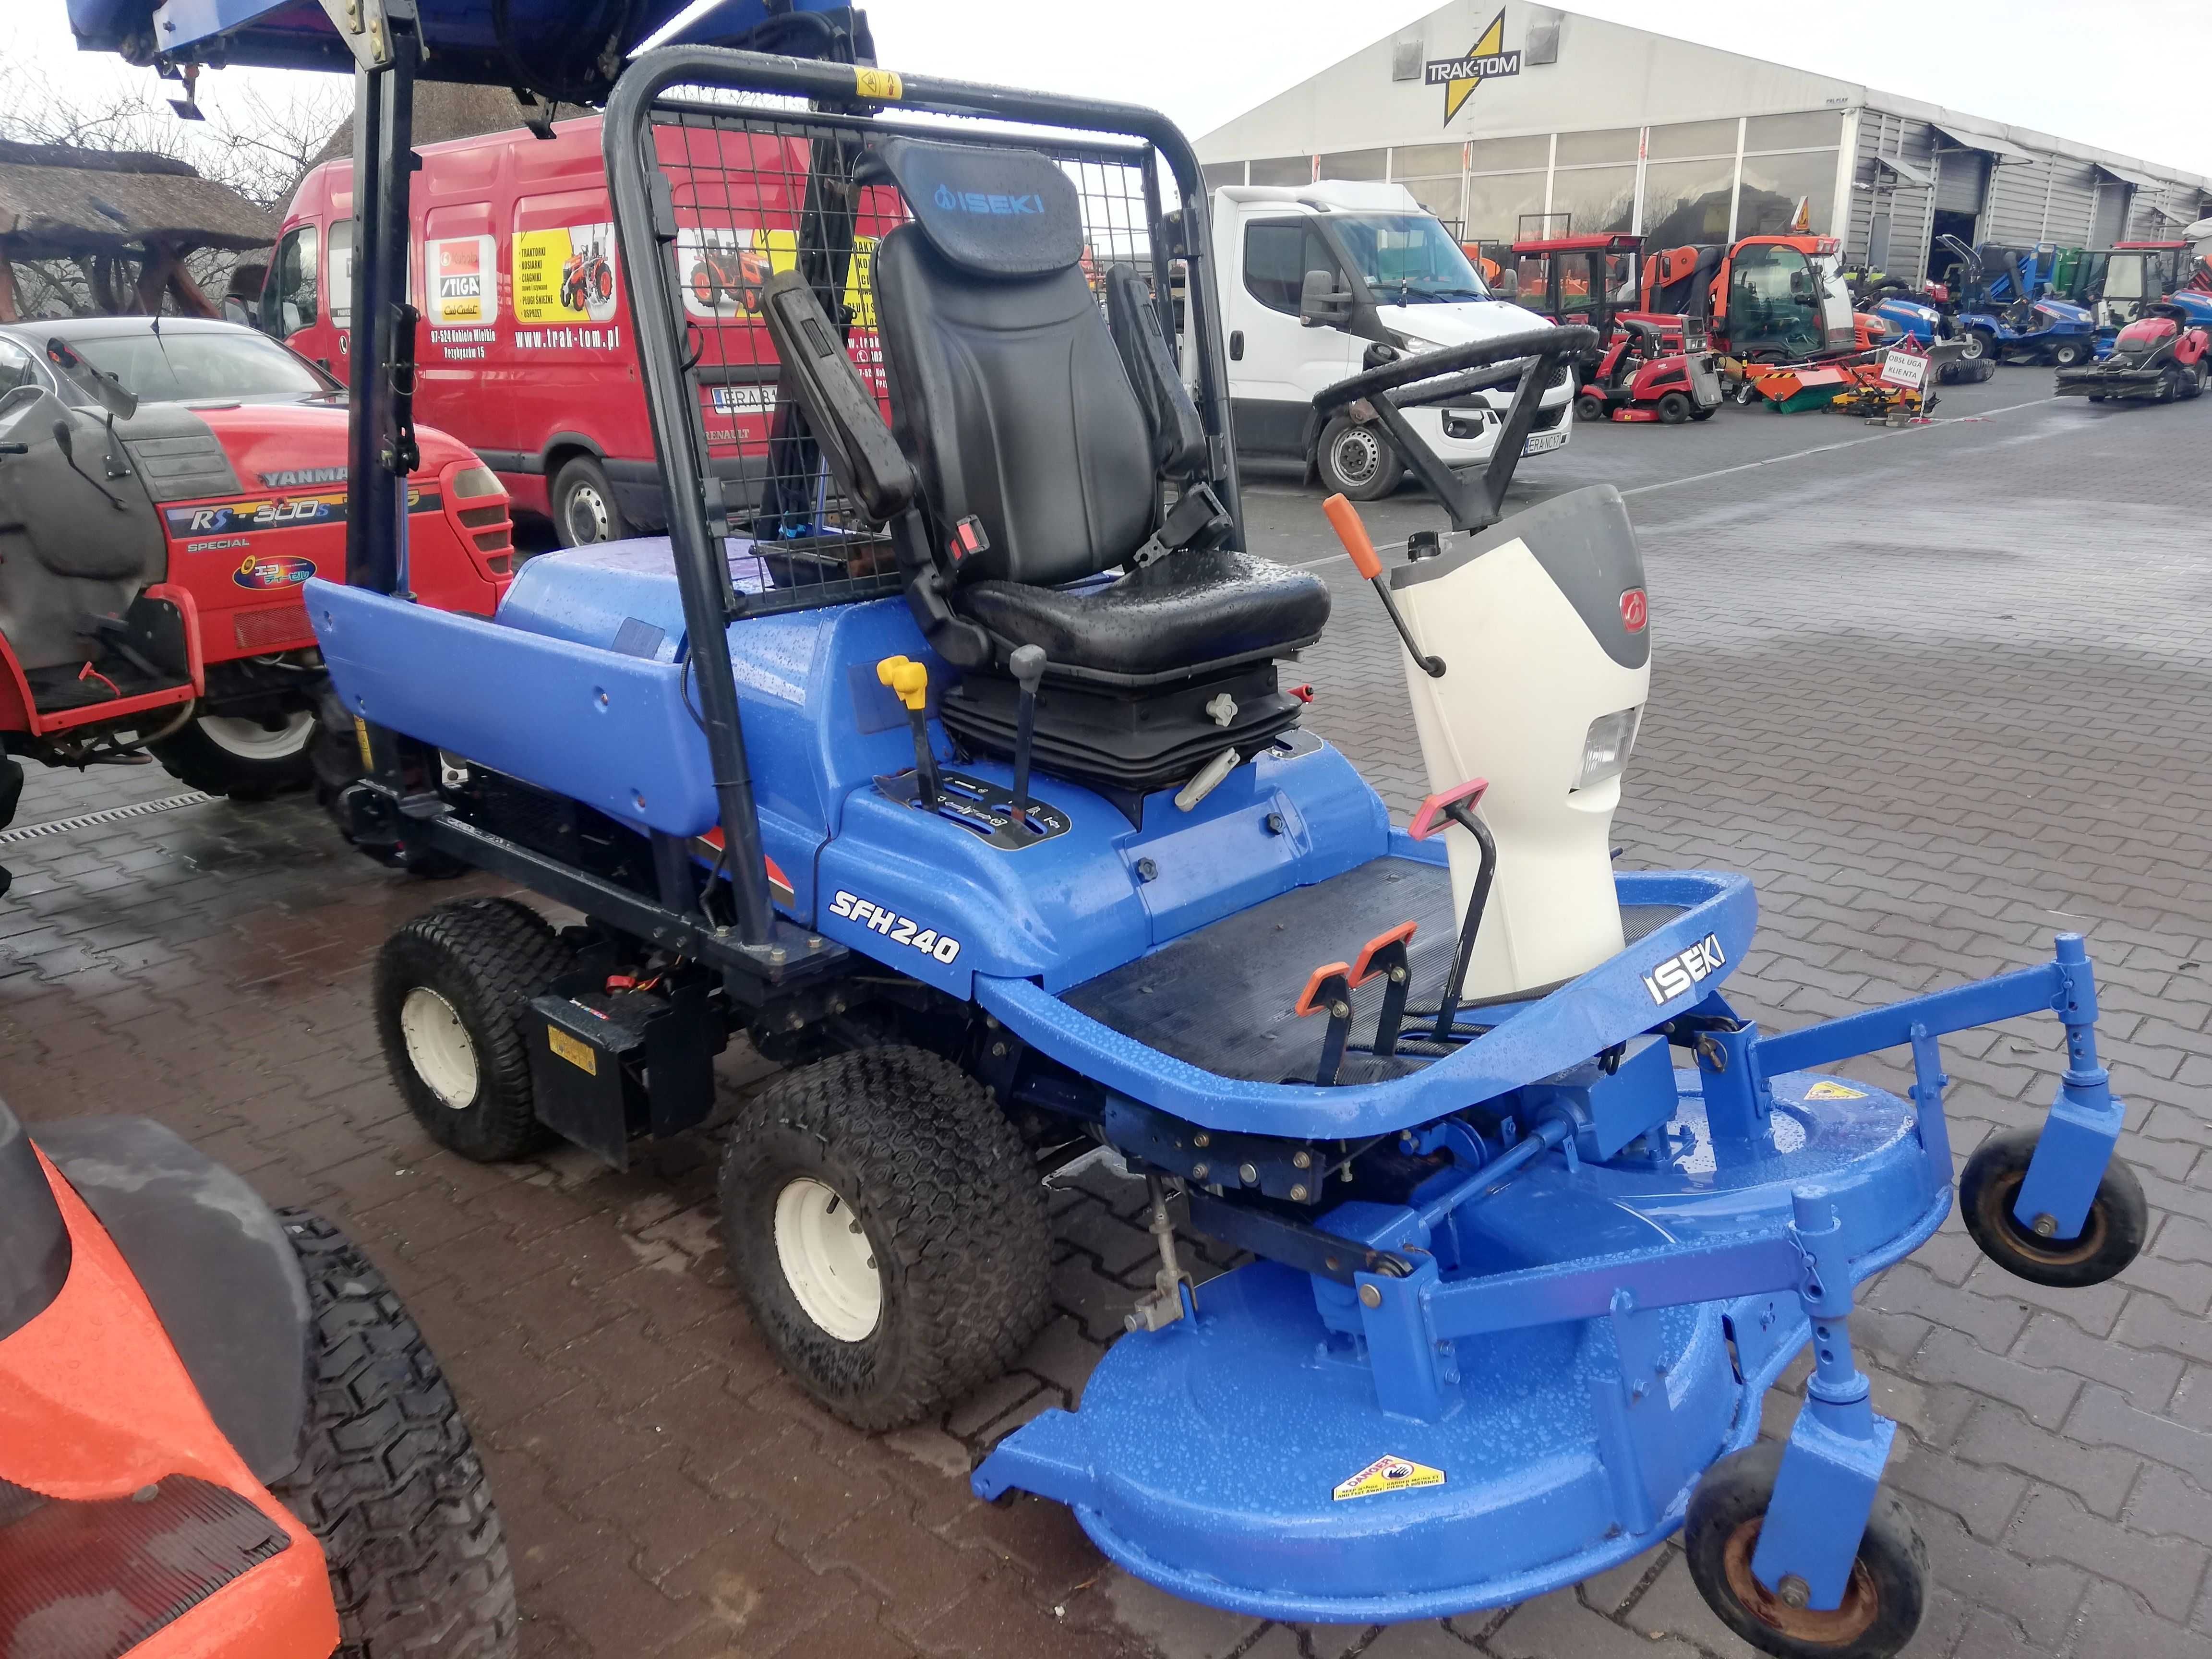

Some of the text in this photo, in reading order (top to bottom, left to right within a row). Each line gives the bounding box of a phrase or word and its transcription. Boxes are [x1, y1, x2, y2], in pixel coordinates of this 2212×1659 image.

[1428, 55, 1517, 81] TRAK-TOM
[957, 191, 1045, 215] ISEKI
[521, 247, 546, 258] TRAKTORKI
[521, 260, 542, 270] KOSIARKI
[522, 273, 541, 284] CIĄGNIKI
[441, 277, 479, 296] STIGA
[522, 295, 535, 305] PŁUGI
[431, 330, 451, 343] 97-524
[515, 325, 619, 351] www.trak-tom.pl
[477, 346, 485, 358] 15
[264, 468, 348, 488] YANMA
[187, 539, 250, 553] SPECIAL
[255, 564, 280, 577] エコ
[265, 570, 310, 585] ディーゼル
[828, 890, 961, 964] SFH240
[1642, 933, 1727, 1006] ISEKI
[1347, 1458, 1393, 1487] DANGER
